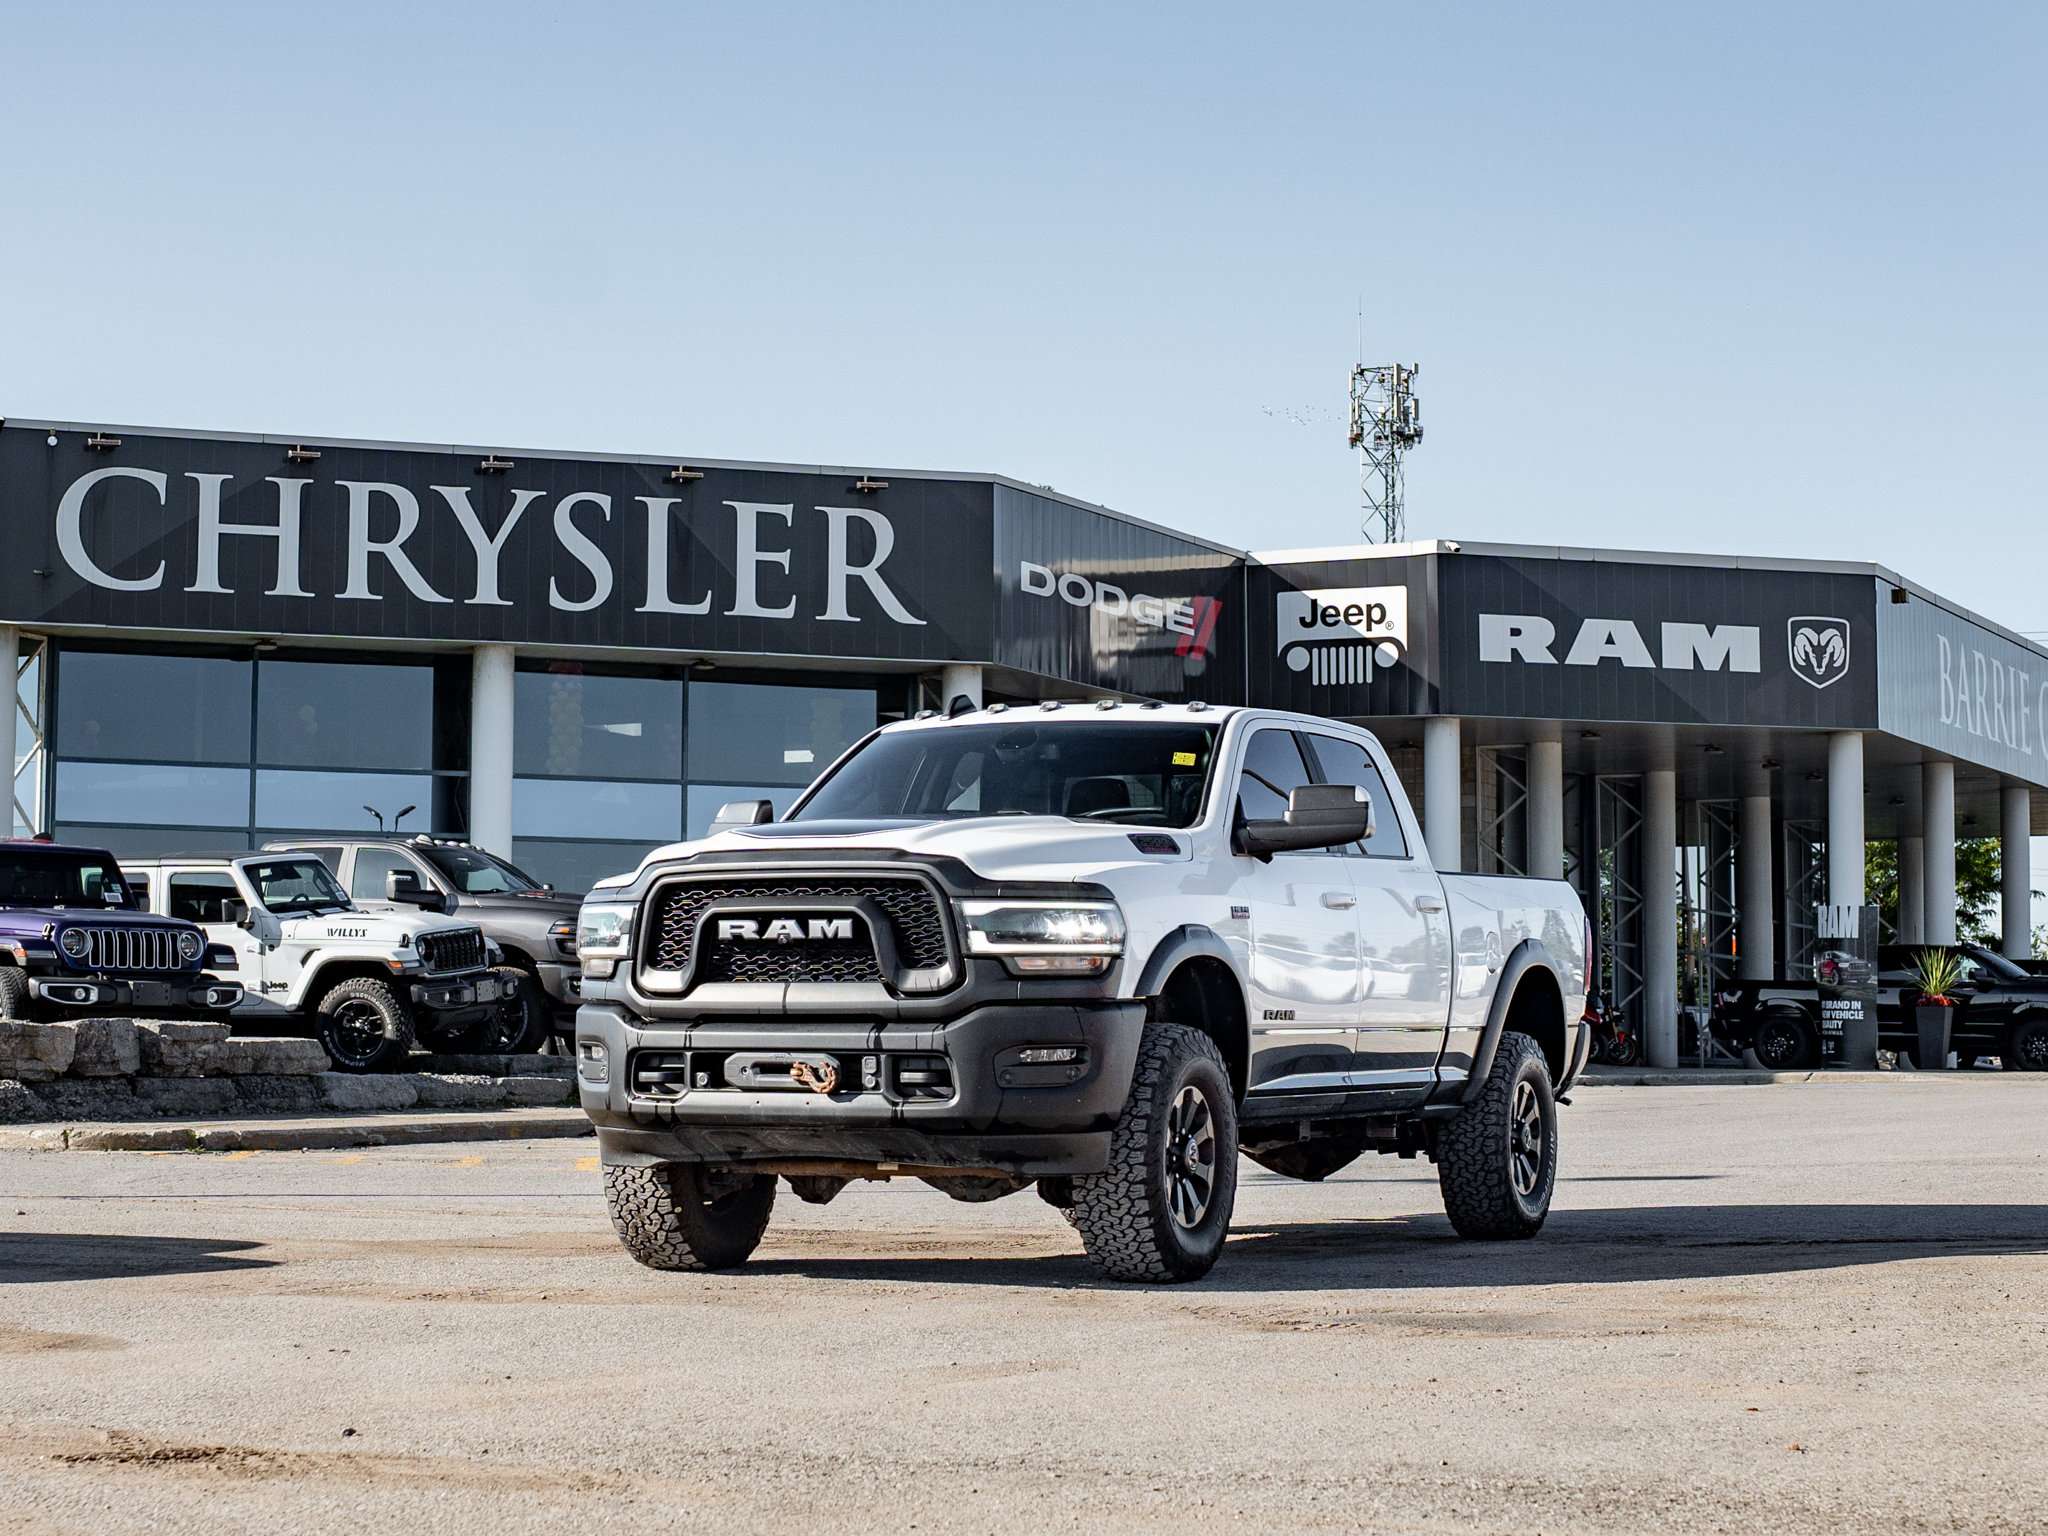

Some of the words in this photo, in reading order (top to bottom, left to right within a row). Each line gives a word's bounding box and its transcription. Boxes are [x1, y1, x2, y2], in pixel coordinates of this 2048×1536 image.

[55, 466, 928, 626] CHRYSLER
[1020, 560, 1195, 636] DODGE
[1299, 598, 1387, 632] Jeep
[1479, 613, 1761, 673] RAM
[1936, 633, 2032, 756] BARRIE
[327, 927, 368, 938] WILLYS
[718, 919, 853, 940] RAM
[1818, 905, 1860, 939] RAM
[268, 981, 288, 990] Jeep
[1263, 1009, 1295, 1020] RAM
[1831, 1010, 1864, 1020] VEHICLE
[1851, 1000, 1862, 1010] IN
